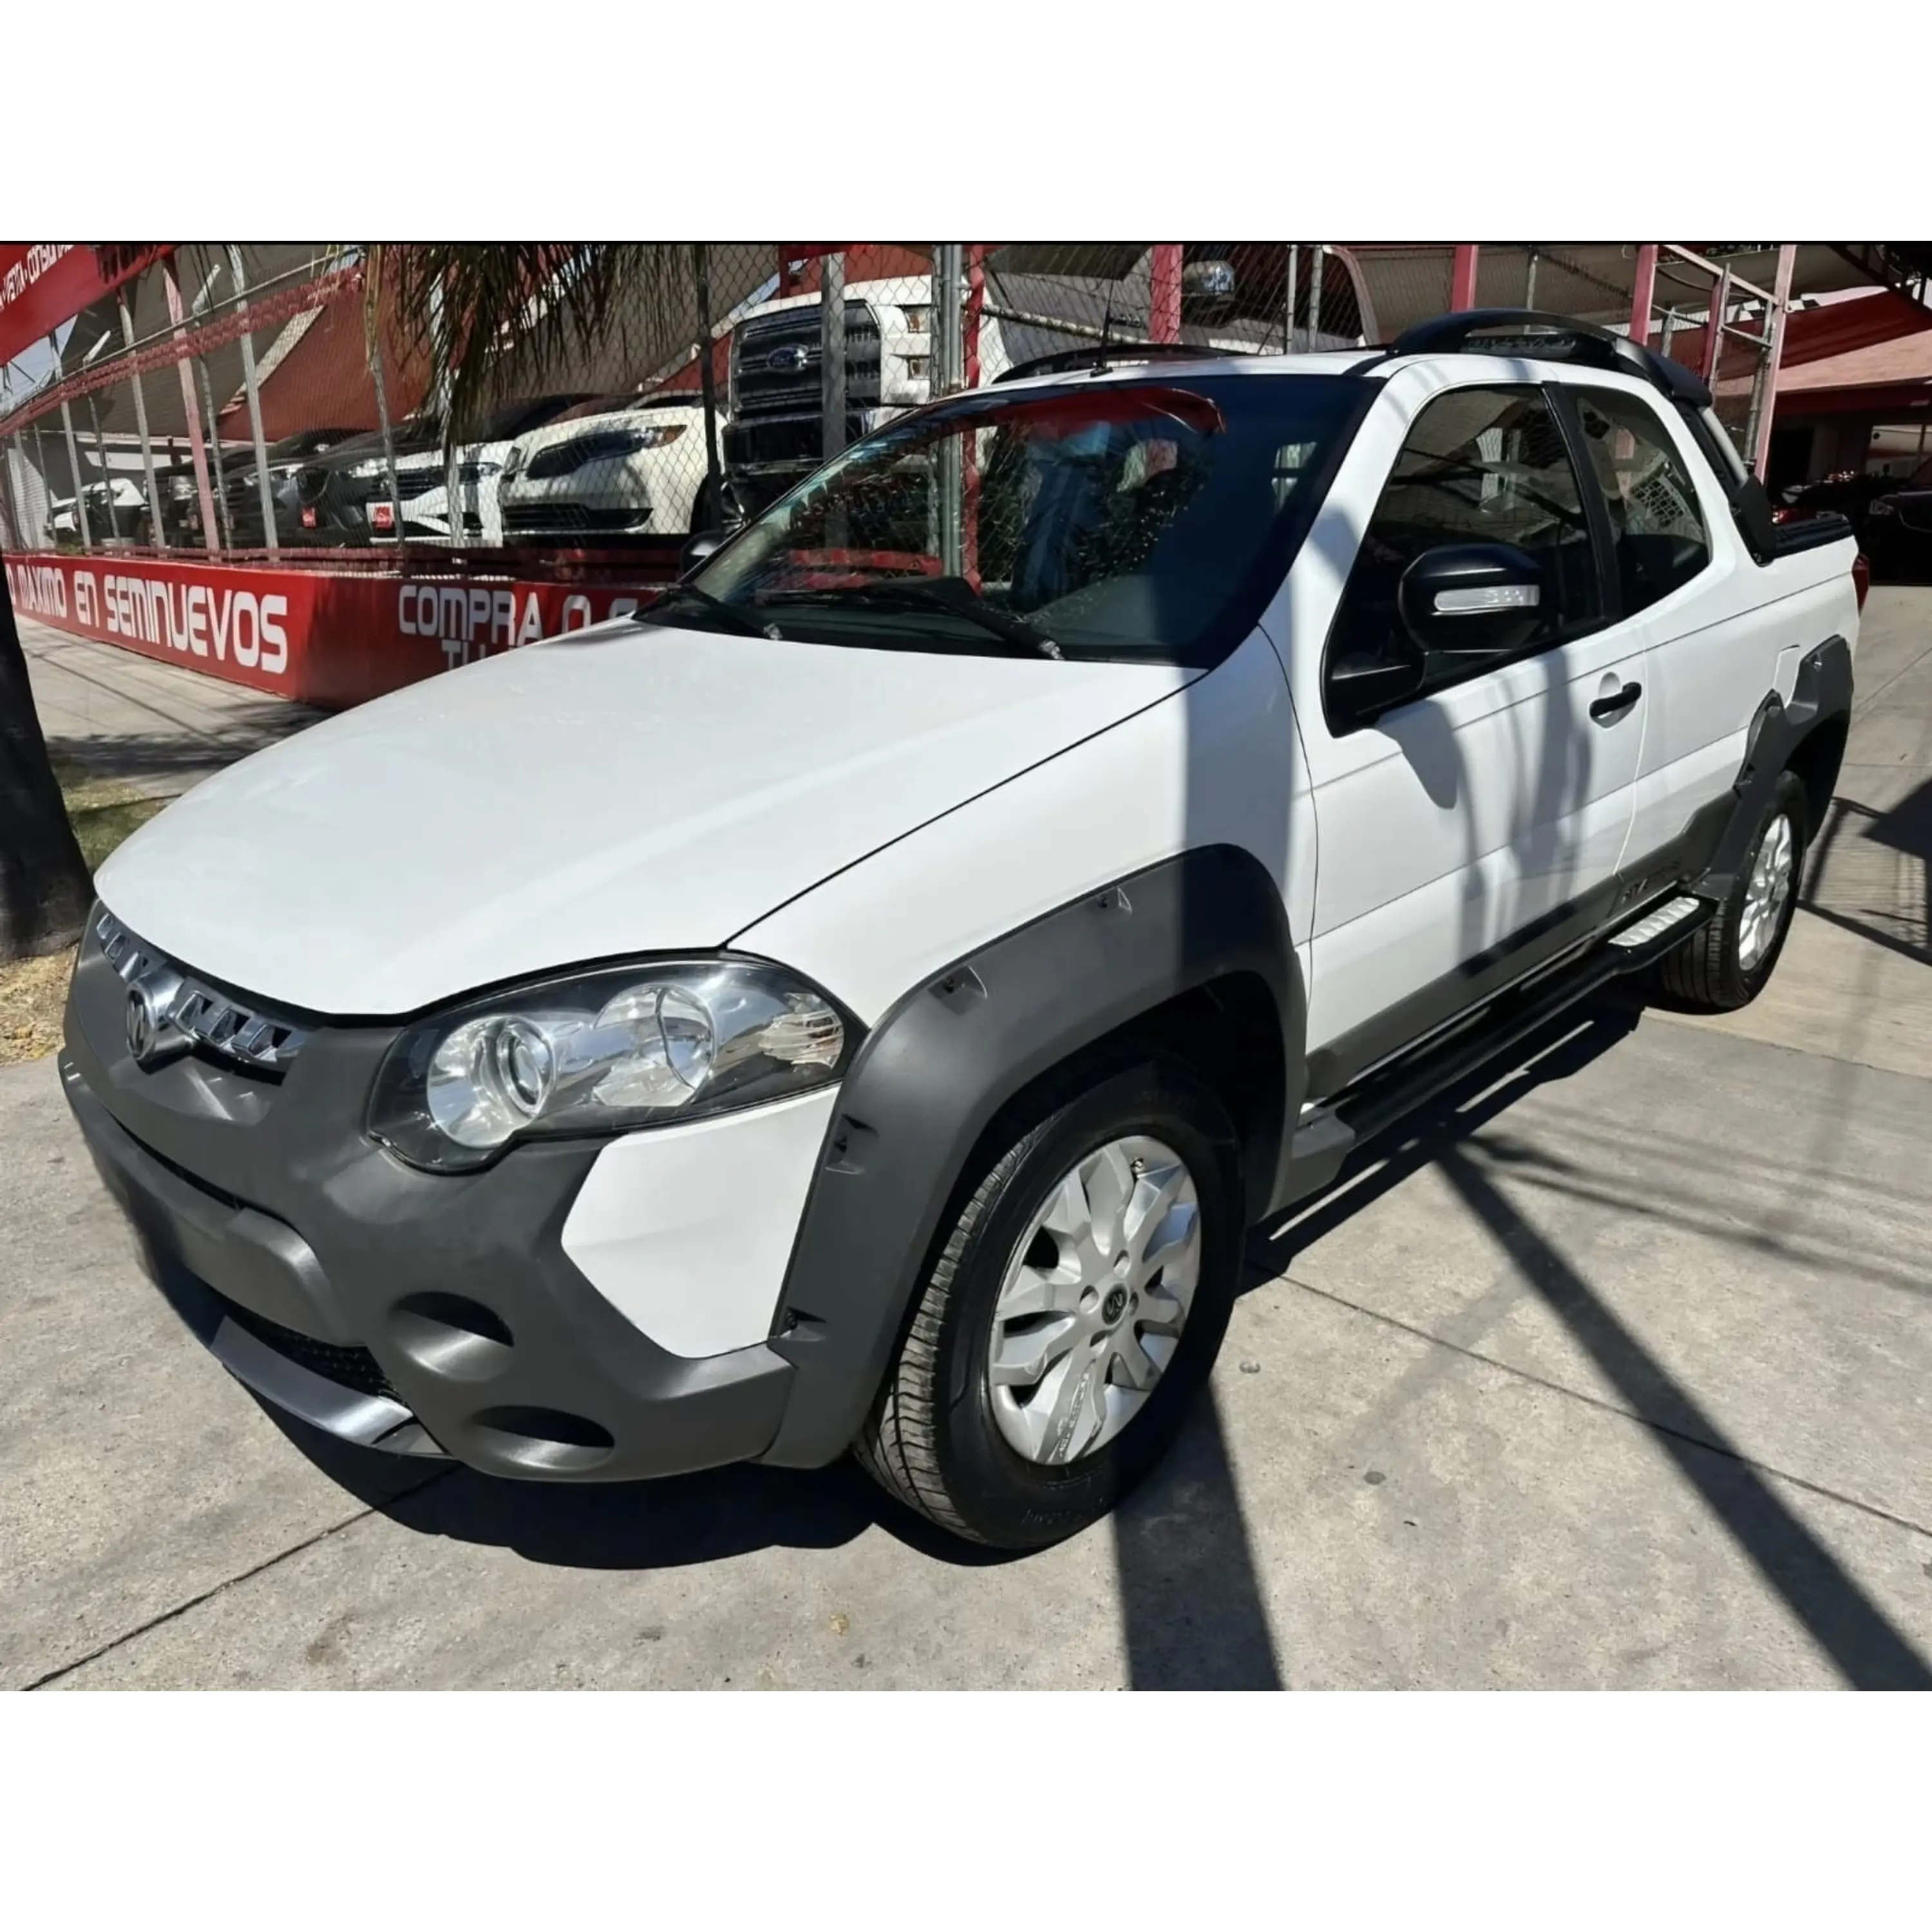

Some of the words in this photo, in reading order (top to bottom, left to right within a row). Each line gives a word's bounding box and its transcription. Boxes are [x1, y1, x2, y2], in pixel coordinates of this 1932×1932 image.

[73, 570, 99, 628] EN
[104, 574, 287, 674] SEMINUEVOS
[399, 585, 544, 646] COMPRA
